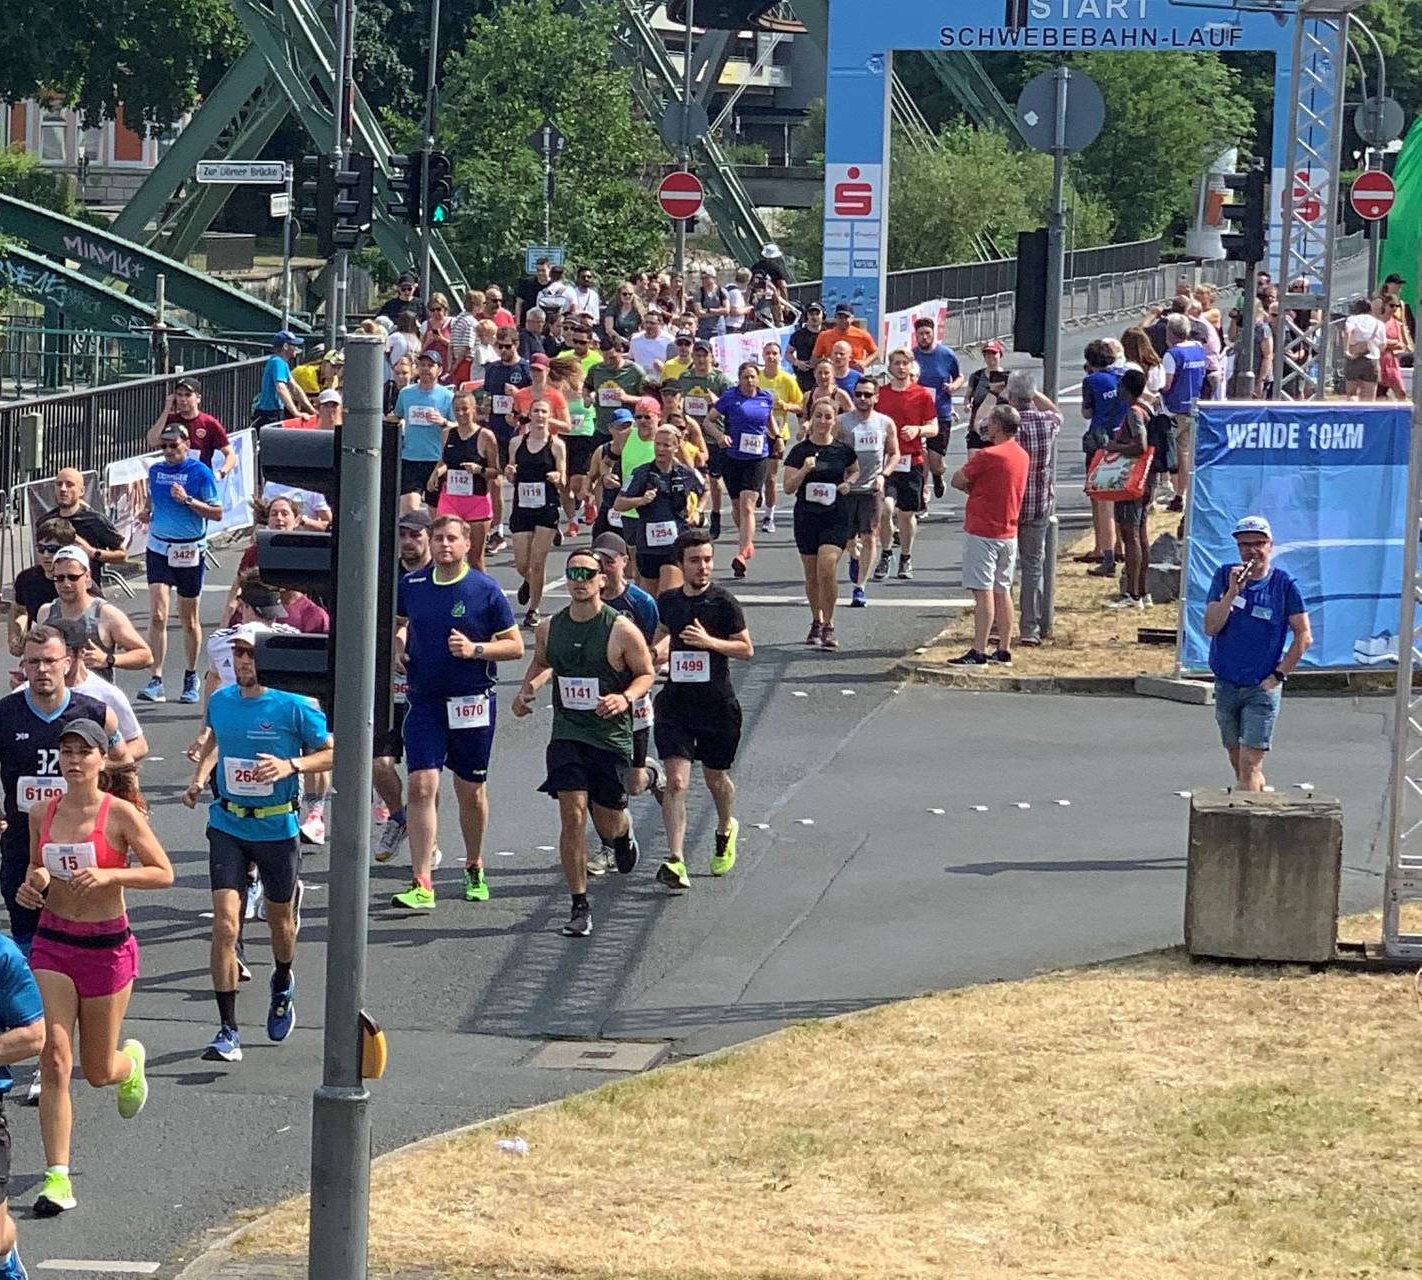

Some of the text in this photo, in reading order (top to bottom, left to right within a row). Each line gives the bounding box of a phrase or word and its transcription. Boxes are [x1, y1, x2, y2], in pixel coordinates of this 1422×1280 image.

[1031, 0, 1147, 19] START
[939, 27, 1244, 47] SCHWEBEBAHN-LAUF
[204, 166, 217, 176] Zur
[251, 166, 277, 176] Brücke
[1226, 422, 1364, 449] WENDE 10KM
[676, 660, 704, 672] 1499
[564, 687, 591, 699] 1141
[455, 704, 483, 717] 1670
[59, 856, 78, 870] 15
